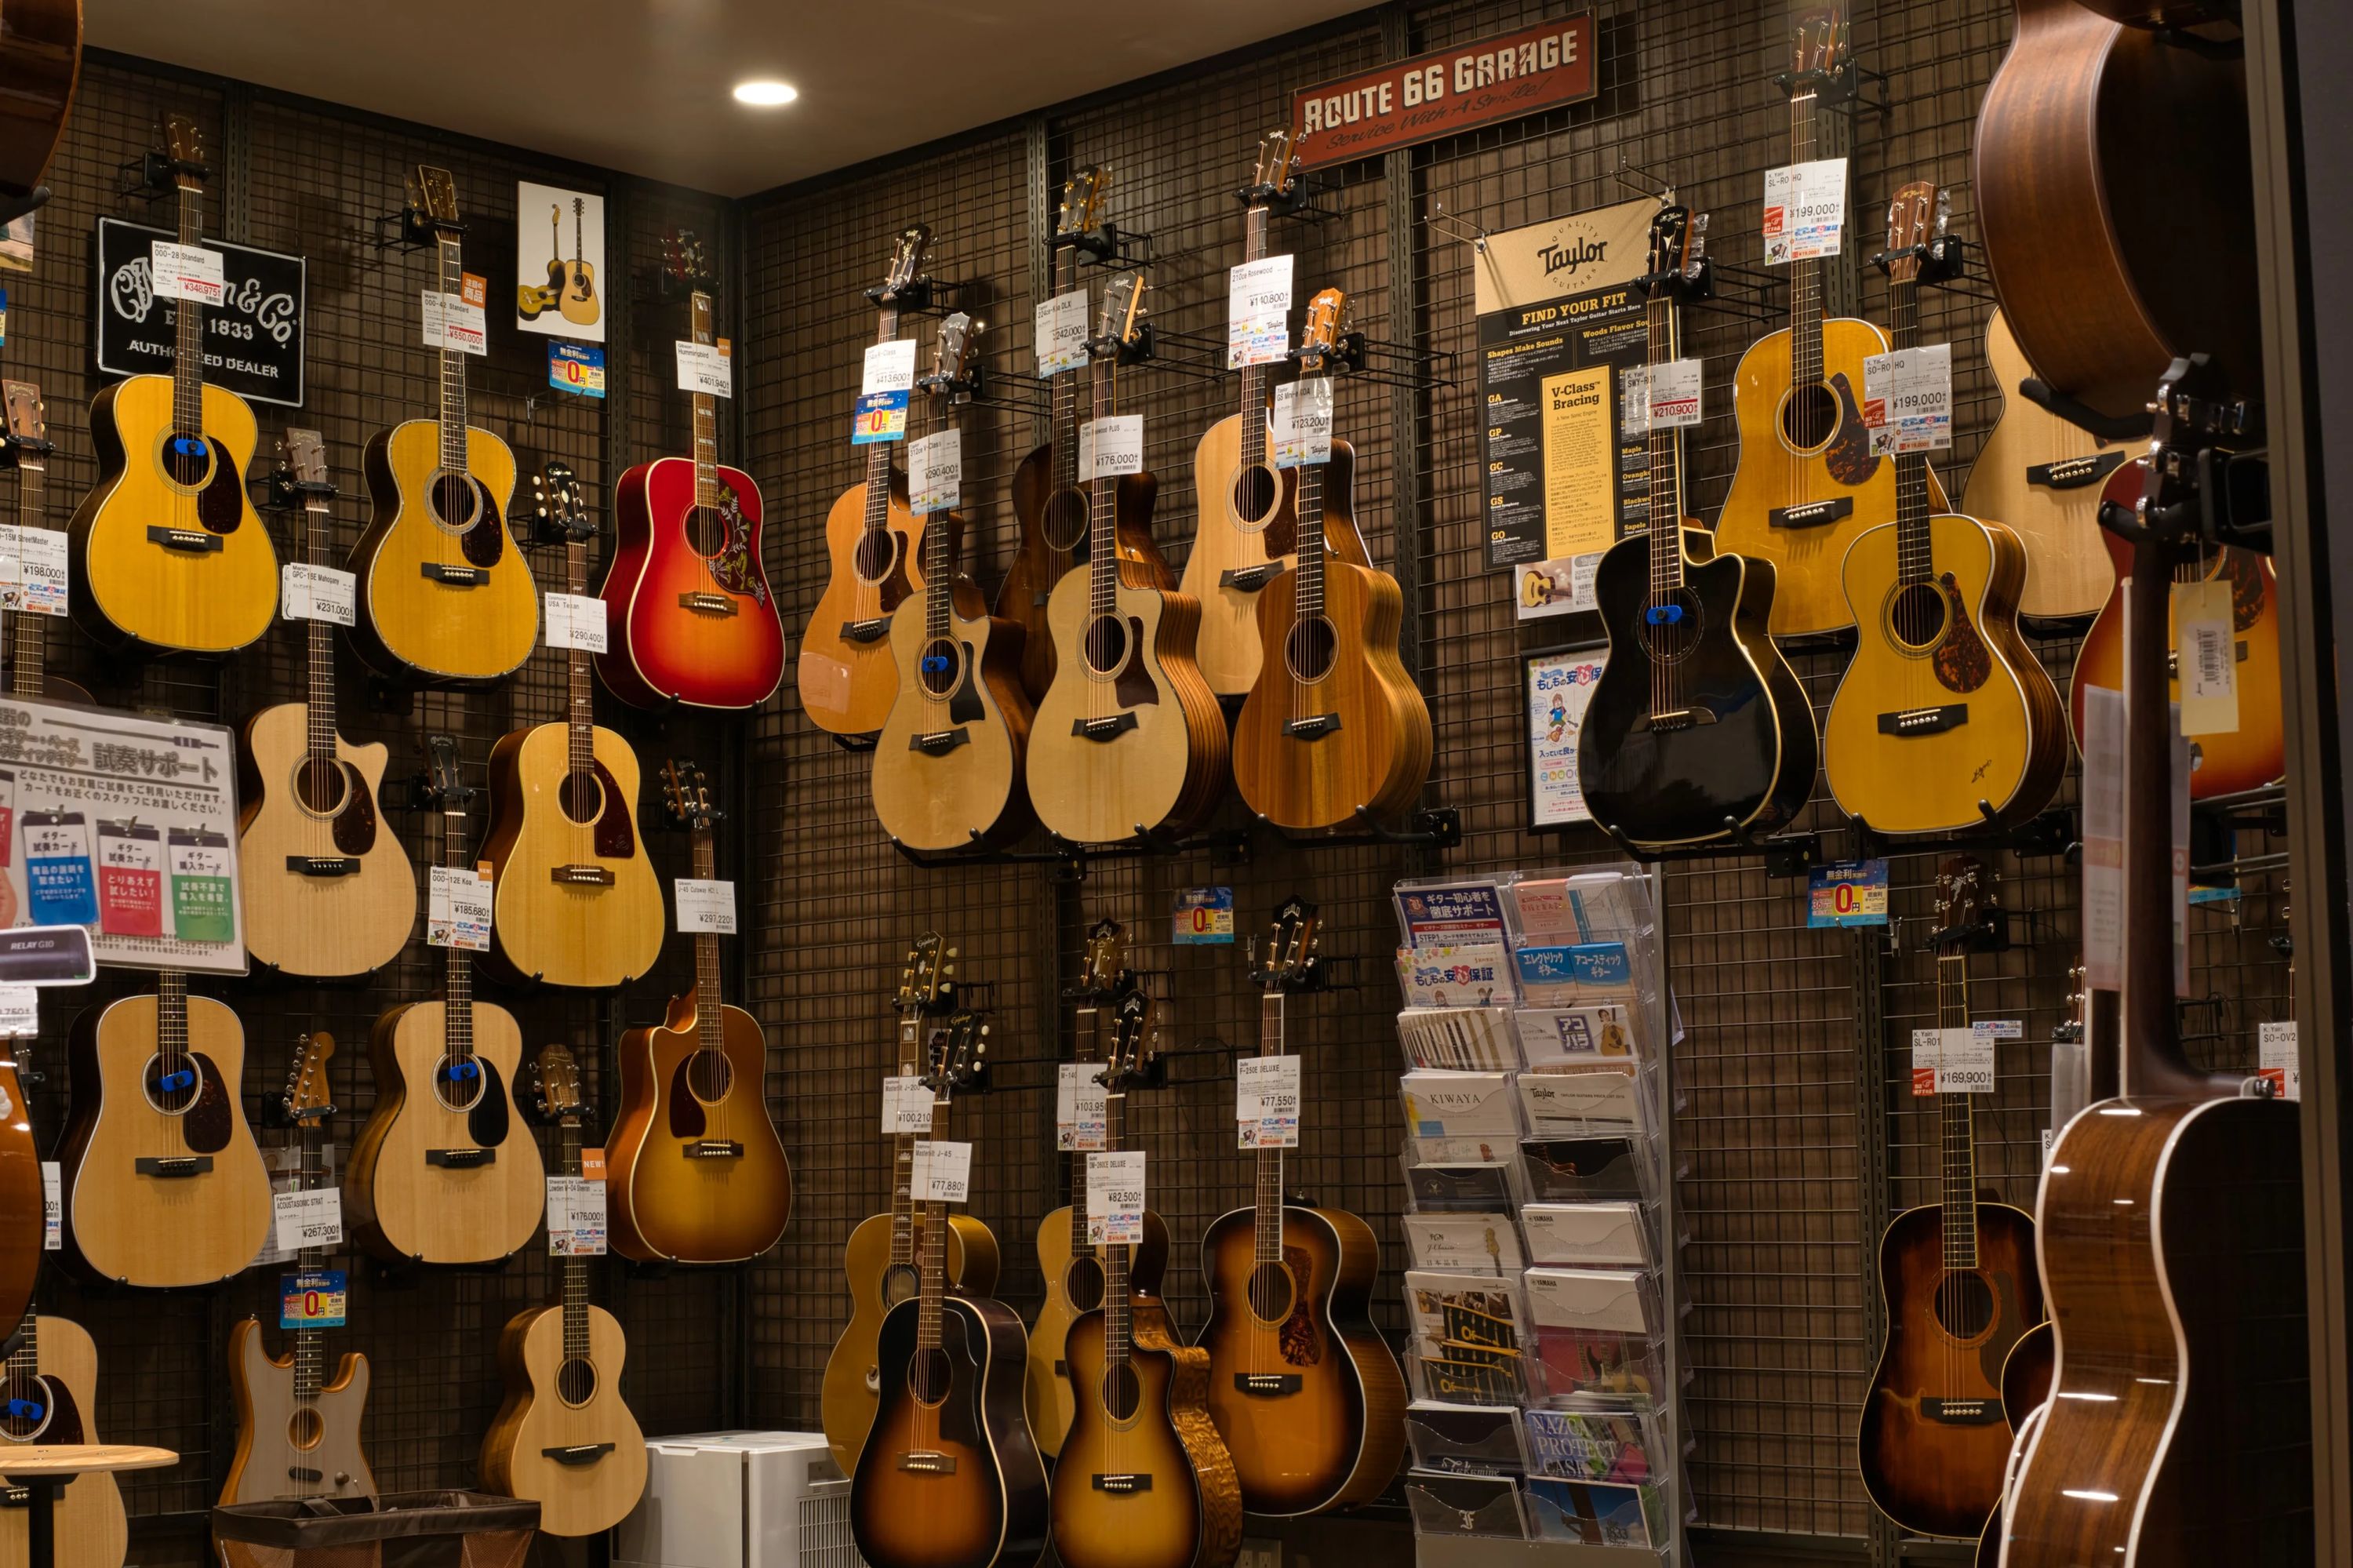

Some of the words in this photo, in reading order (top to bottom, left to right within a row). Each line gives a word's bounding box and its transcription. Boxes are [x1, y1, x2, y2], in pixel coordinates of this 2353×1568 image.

[1304, 82, 1392, 134] ROUTE
[1403, 64, 1444, 107] 66
[1454, 30, 1577, 93] GARAGE
[1326, 123, 1396, 150] Service
[1400, 105, 1448, 131] With
[1450, 99, 1471, 117] A
[1791, 204, 1835, 220] ¥199,000
[1552, 220, 1599, 242] QUALITY
[155, 248, 180, 260] 000-28
[181, 252, 205, 264] Standard
[1537, 237, 1608, 278] Taylor
[1248, 267, 1274, 278] Rosewood
[1552, 267, 1597, 289] GUITARS
[184, 282, 219, 297] ¥348,975
[449, 302, 470, 314] Standard
[1522, 308, 1557, 326] FIND
[1559, 299, 1599, 317] YOUR
[1602, 292, 1627, 308] FIT
[1508, 324, 1540, 337] Discovering
[1541, 322, 1555, 330] Your
[1556, 318, 1569, 327] Next
[1570, 315, 1588, 325] Taylor
[1589, 311, 1607, 320] Guitar
[1608, 307, 1627, 316] Starts
[210, 318, 253, 340] 1833
[1583, 328, 1608, 339] Woods
[1609, 323, 1635, 334] Flavor
[449, 329, 481, 344] ¥550,000
[678, 349, 709, 359] Hummingbird
[1487, 346, 1514, 359] Shapes
[1515, 342, 1536, 353] Make
[1536, 337, 1563, 349] Sounds
[226, 358, 279, 378] DEALER
[1894, 361, 1904, 370] HQ
[699, 376, 727, 389] ¥401,940
[1488, 394, 1502, 403] GA
[1553, 394, 1601, 410] Bracing
[1894, 393, 1942, 409] ¥199,000
[1653, 403, 1694, 418] ¥210,900
[1292, 417, 1326, 430] ¥123,200
[1489, 428, 1502, 438] GP
[1622, 446, 1642, 455] Maple
[1096, 453, 1134, 467] ¥176,000
[1489, 461, 1504, 471] GC
[1490, 496, 1504, 506] GS
[1624, 521, 1646, 531] Sapele
[18, 536, 49, 546] StreetMaster
[1492, 530, 1506, 540] GO
[24, 565, 61, 579] ¥198,000
[318, 574, 339, 586] Mahogany
[316, 602, 350, 617] ¥231,000
[563, 602, 580, 610] Texan
[1537, 664, 1603, 690] もしもの安心保
[93, 742, 220, 784] 試奏サポート
[42, 831, 67, 841] ギター
[33, 842, 78, 853] 試奏カード
[118, 843, 142, 853] ギター
[109, 853, 151, 866] 試奏カード
[187, 851, 213, 862] ギター
[180, 860, 222, 873] 購入カード
[107, 874, 155, 887] とりあえず
[432, 875, 461, 886] 000-12E
[461, 878, 472, 887] Koa
[1826, 869, 1852, 880] 無金利
[1427, 892, 1490, 905] ギター初心者を
[454, 904, 486, 917] ¥185,680
[1430, 904, 1494, 920] 徹底サポート
[10, 941, 38, 951] RELAY
[38, 940, 54, 949] G10
[1524, 952, 1563, 966] エレクトリック
[1575, 955, 1621, 966] アコースティック
[1415, 966, 1494, 986] もしもの安心保証
[1538, 965, 1558, 977] ギター
[1591, 966, 1611, 977] ギター
[1260, 1063, 1280, 1073] DELUXE
[1940, 1071, 1986, 1084] ¥169,900
[1260, 1095, 1293, 1107] ¥77,550
[1431, 1093, 1482, 1104] KIWAYA
[898, 1112, 931, 1123] ¥100,210
[932, 1180, 962, 1191] ¥77,880
[276, 1194, 293, 1203] Fender
[311, 1196, 324, 1206] STRAT
[1108, 1192, 1138, 1202] ¥82,500
[571, 1212, 601, 1222] ¥176,000
[1533, 1215, 1554, 1224] YAMAHA
[303, 1224, 336, 1239] ¥267,300
[1537, 1279, 1557, 1287] YAMAHA
[1531, 1415, 1591, 1439] NAZCA
[1537, 1436, 1617, 1459] PROTECT
[1606, 1526, 1629, 1539] 1833
